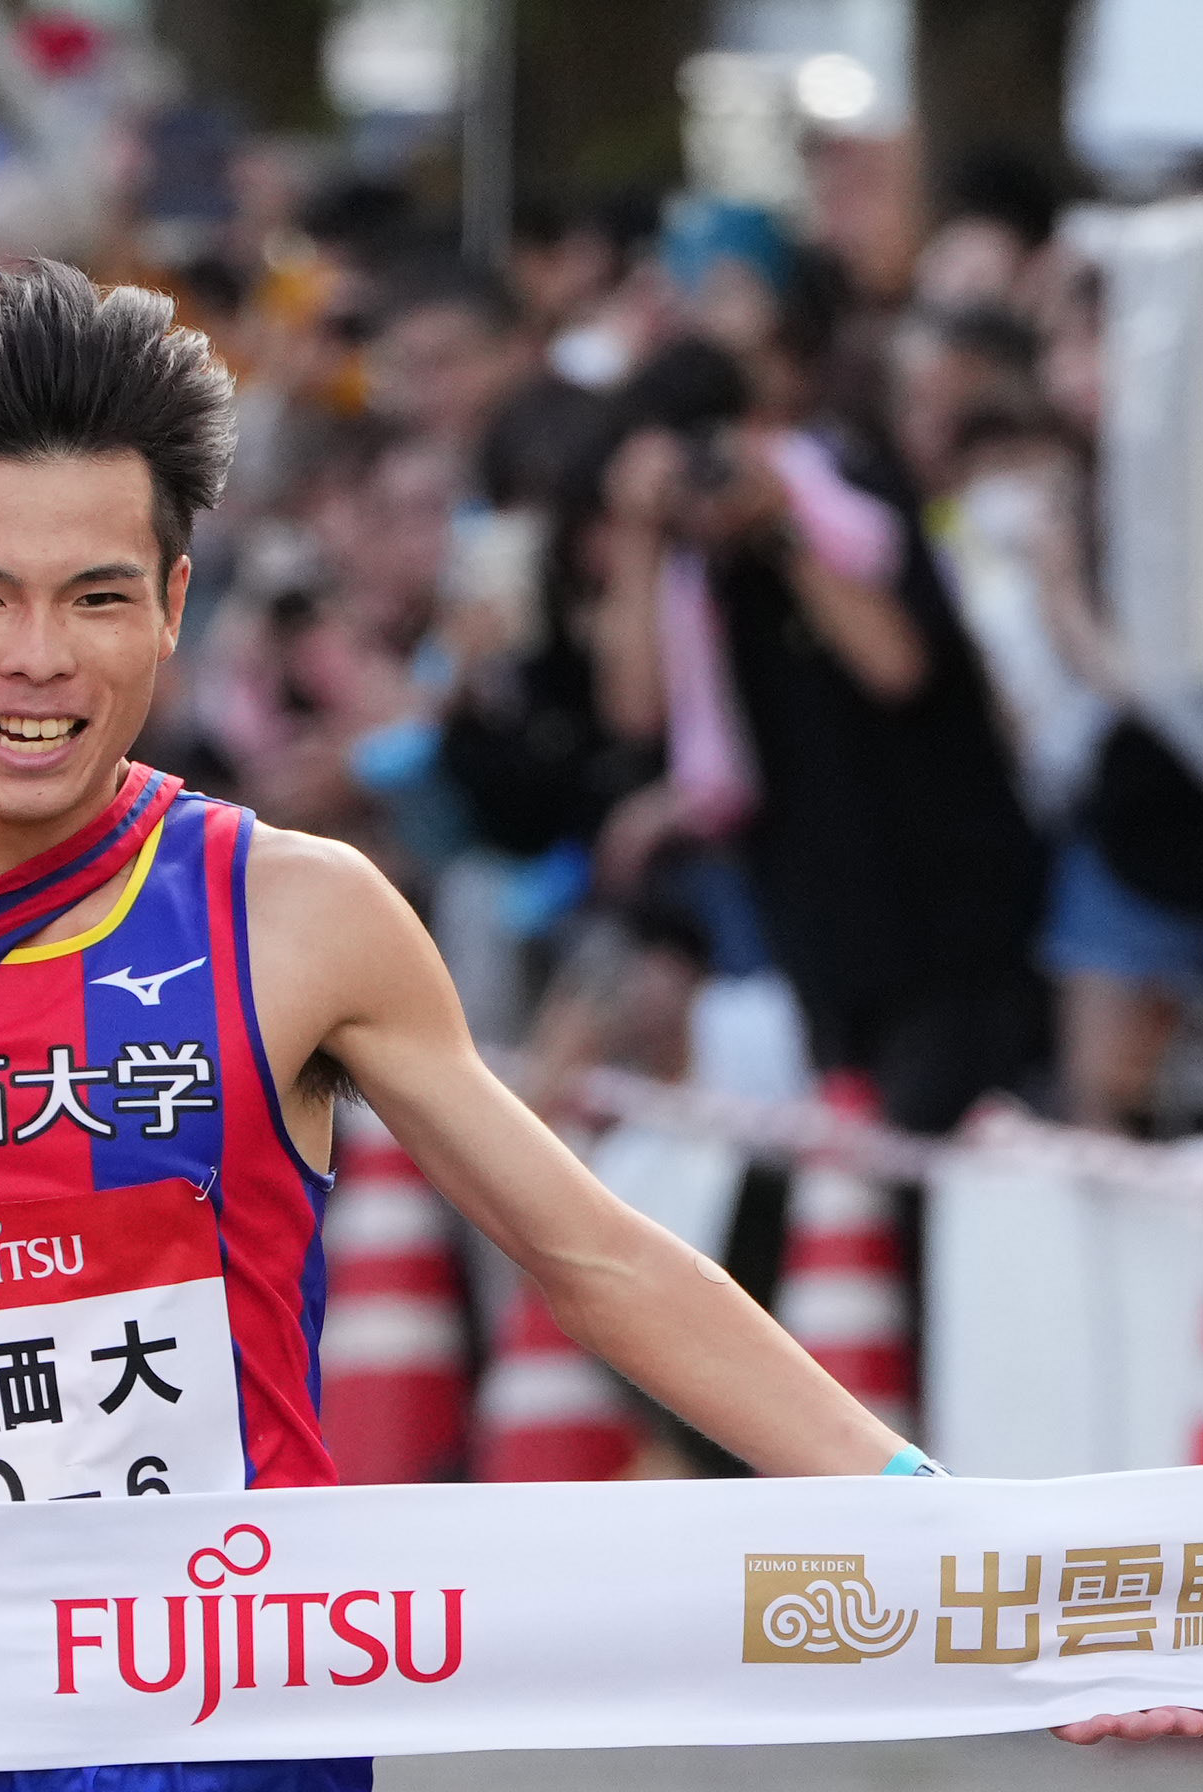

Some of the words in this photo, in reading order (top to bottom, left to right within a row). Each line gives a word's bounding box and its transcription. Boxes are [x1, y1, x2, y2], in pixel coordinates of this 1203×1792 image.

[748, 1560, 797, 1572] IZUMO
[801, 1560, 856, 1573] EKIDEN
[51, 1588, 467, 1726] FUJITSU
